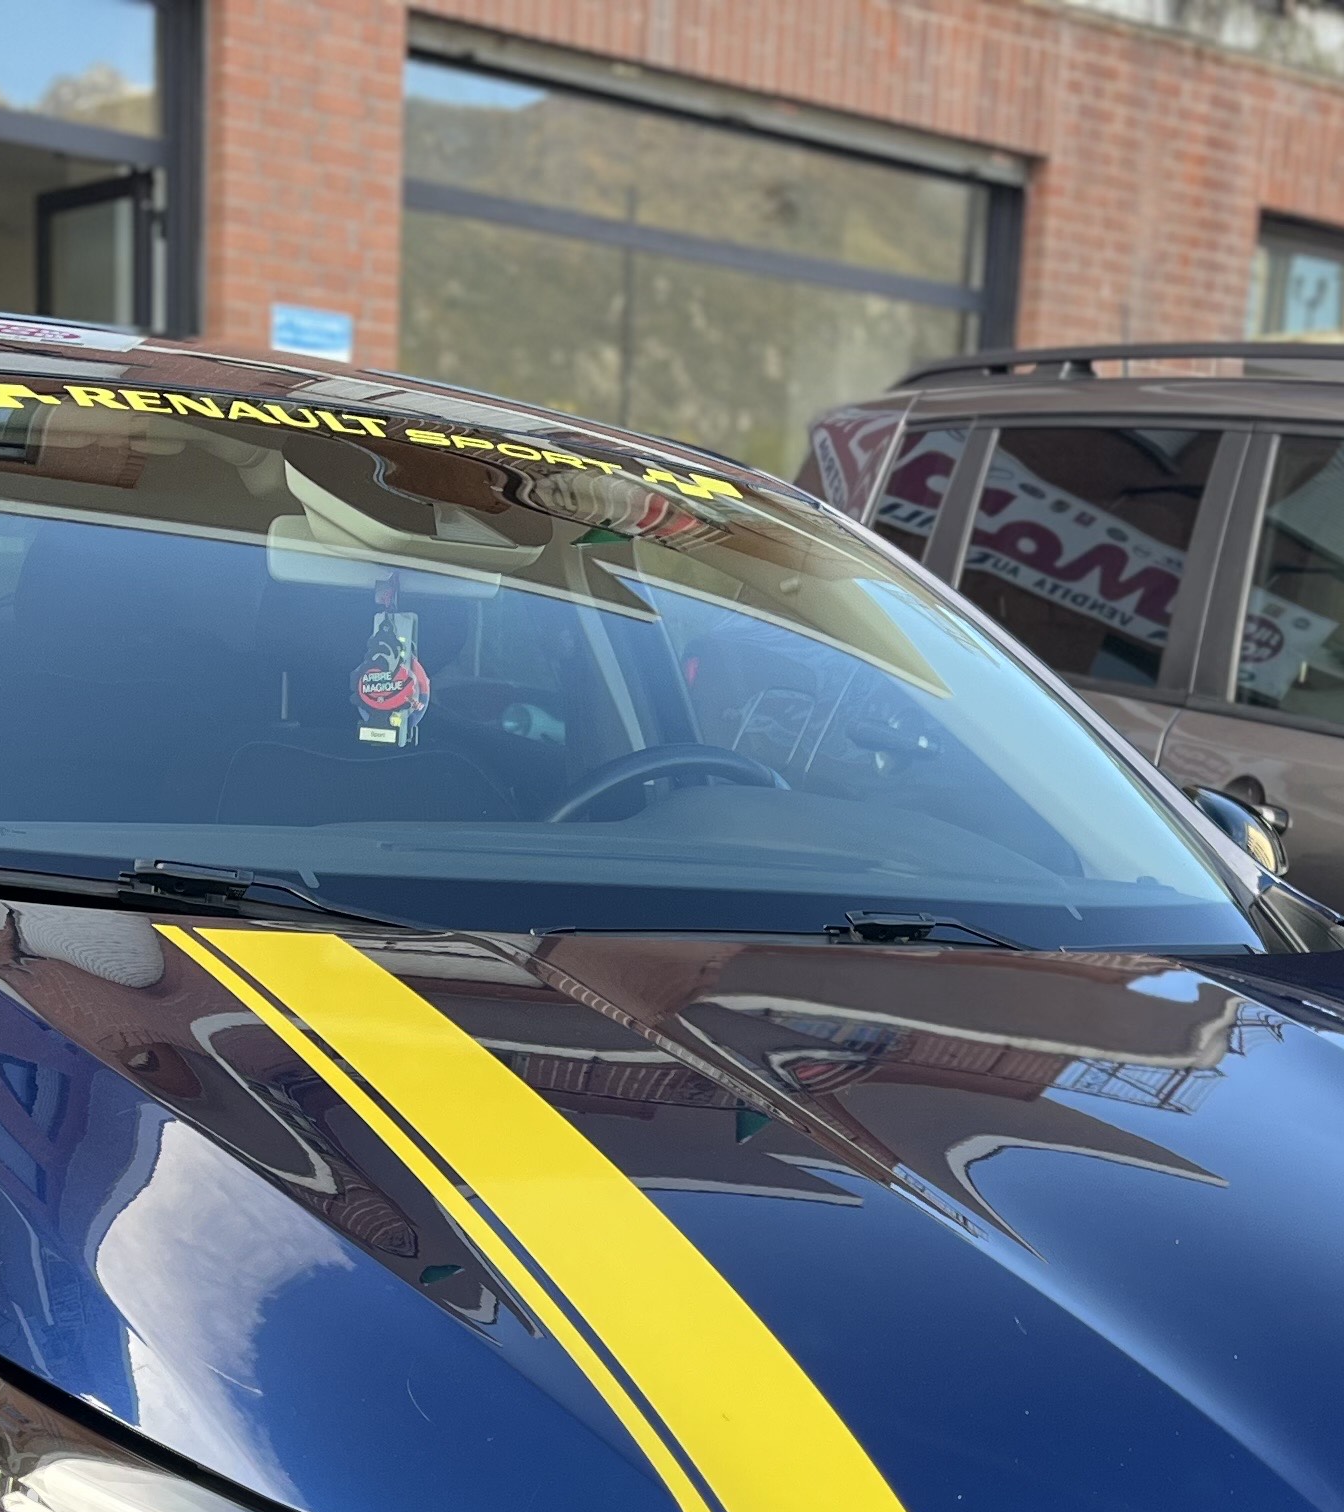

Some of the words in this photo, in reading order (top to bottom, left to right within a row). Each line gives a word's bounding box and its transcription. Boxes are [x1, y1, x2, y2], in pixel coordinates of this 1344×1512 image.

[63, 385, 388, 438] RENAULT
[404, 428, 622, 475] SPORT
[362, 672, 391, 682] ARBRE
[362, 681, 403, 693] MAGIQUE
